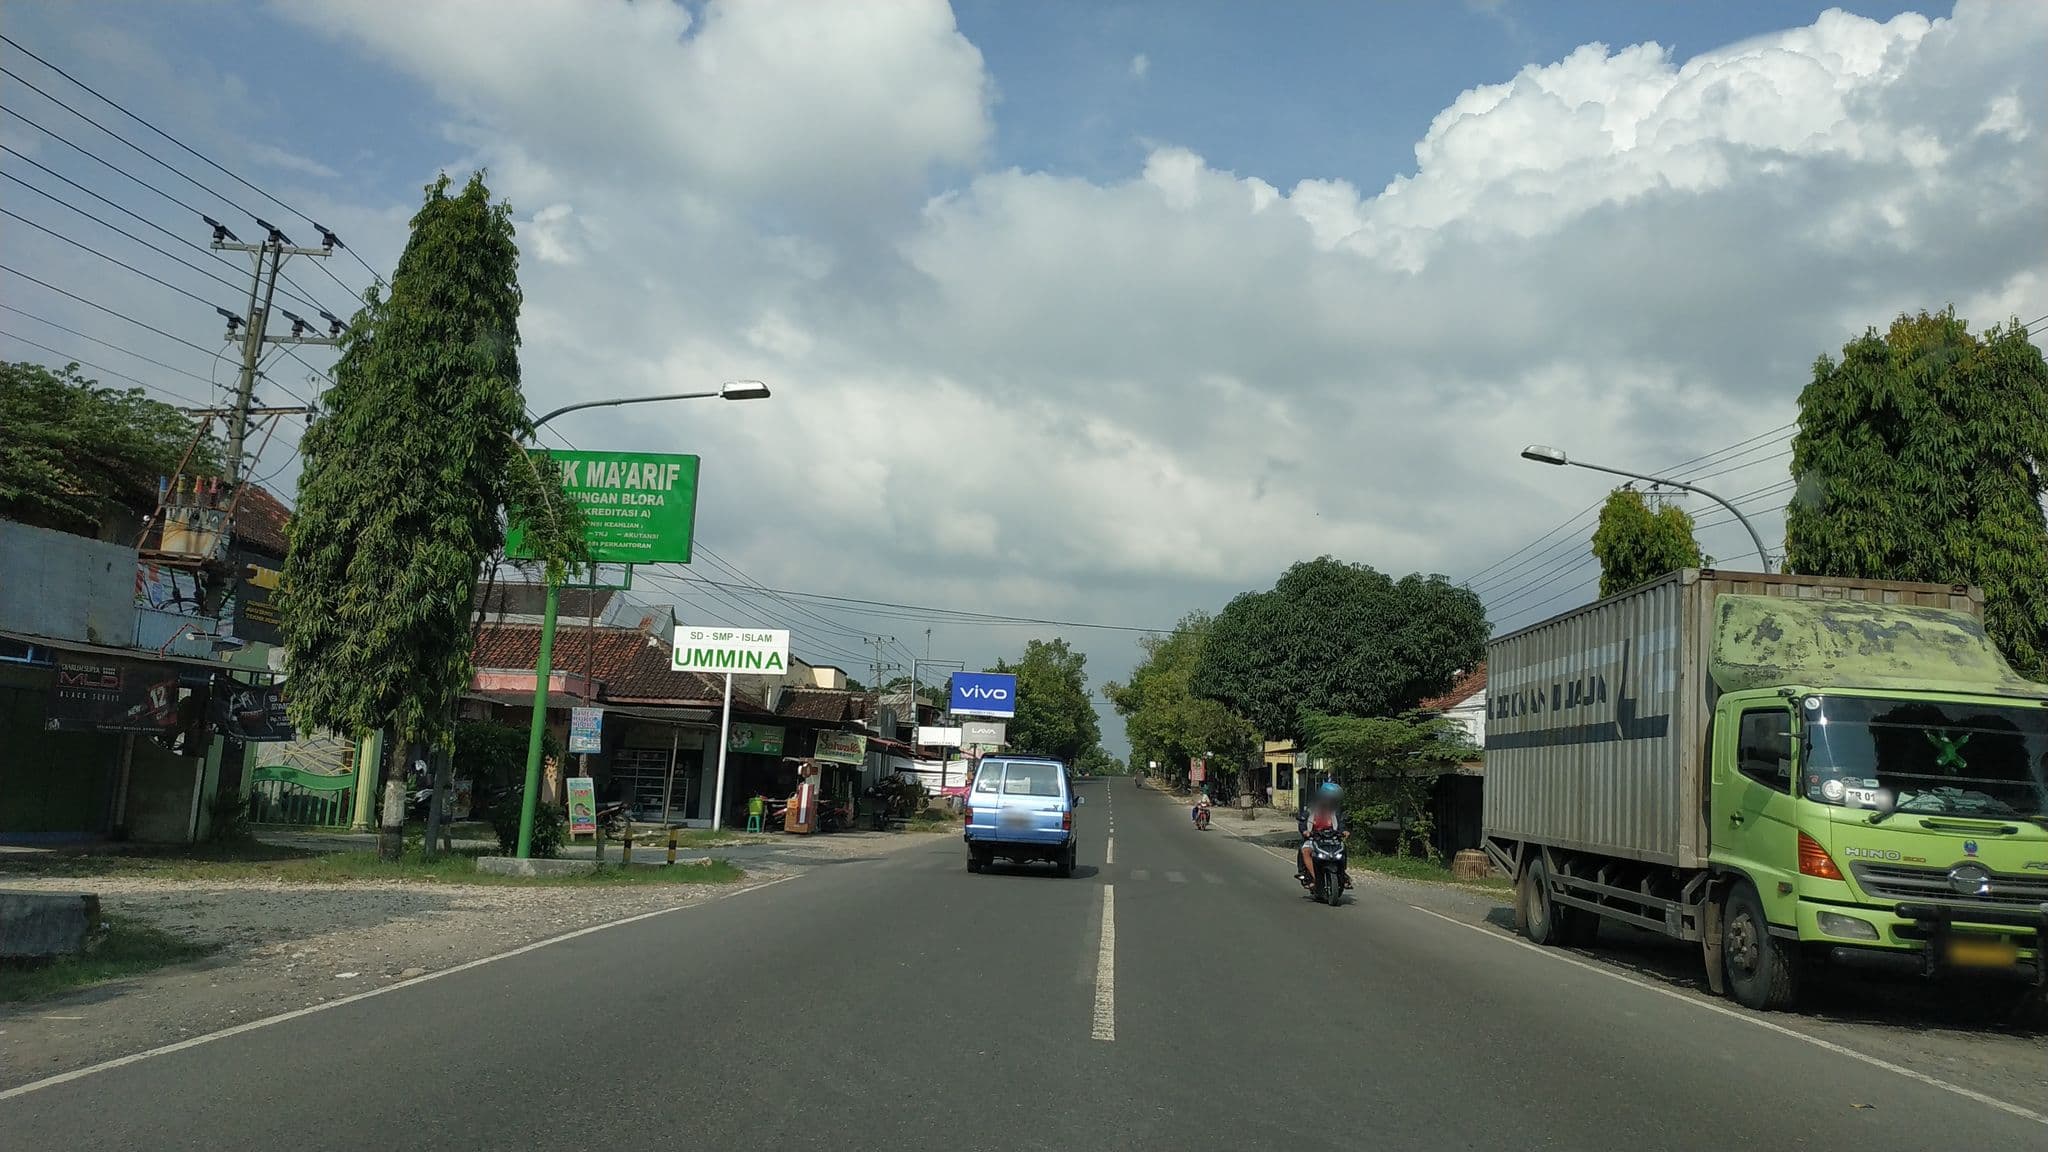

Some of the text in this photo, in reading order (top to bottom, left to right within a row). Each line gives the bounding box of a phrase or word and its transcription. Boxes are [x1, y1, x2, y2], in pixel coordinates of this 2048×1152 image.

[622, 494, 664, 505] BLORA
[690, 631, 704, 640] SD
[712, 632, 734, 641] SMP
[742, 633, 773, 642] ISLAM
[674, 648, 783, 670] UMMINA
[960, 684, 1007, 700] vivo
[1844, 847, 1901, 862] HINO
